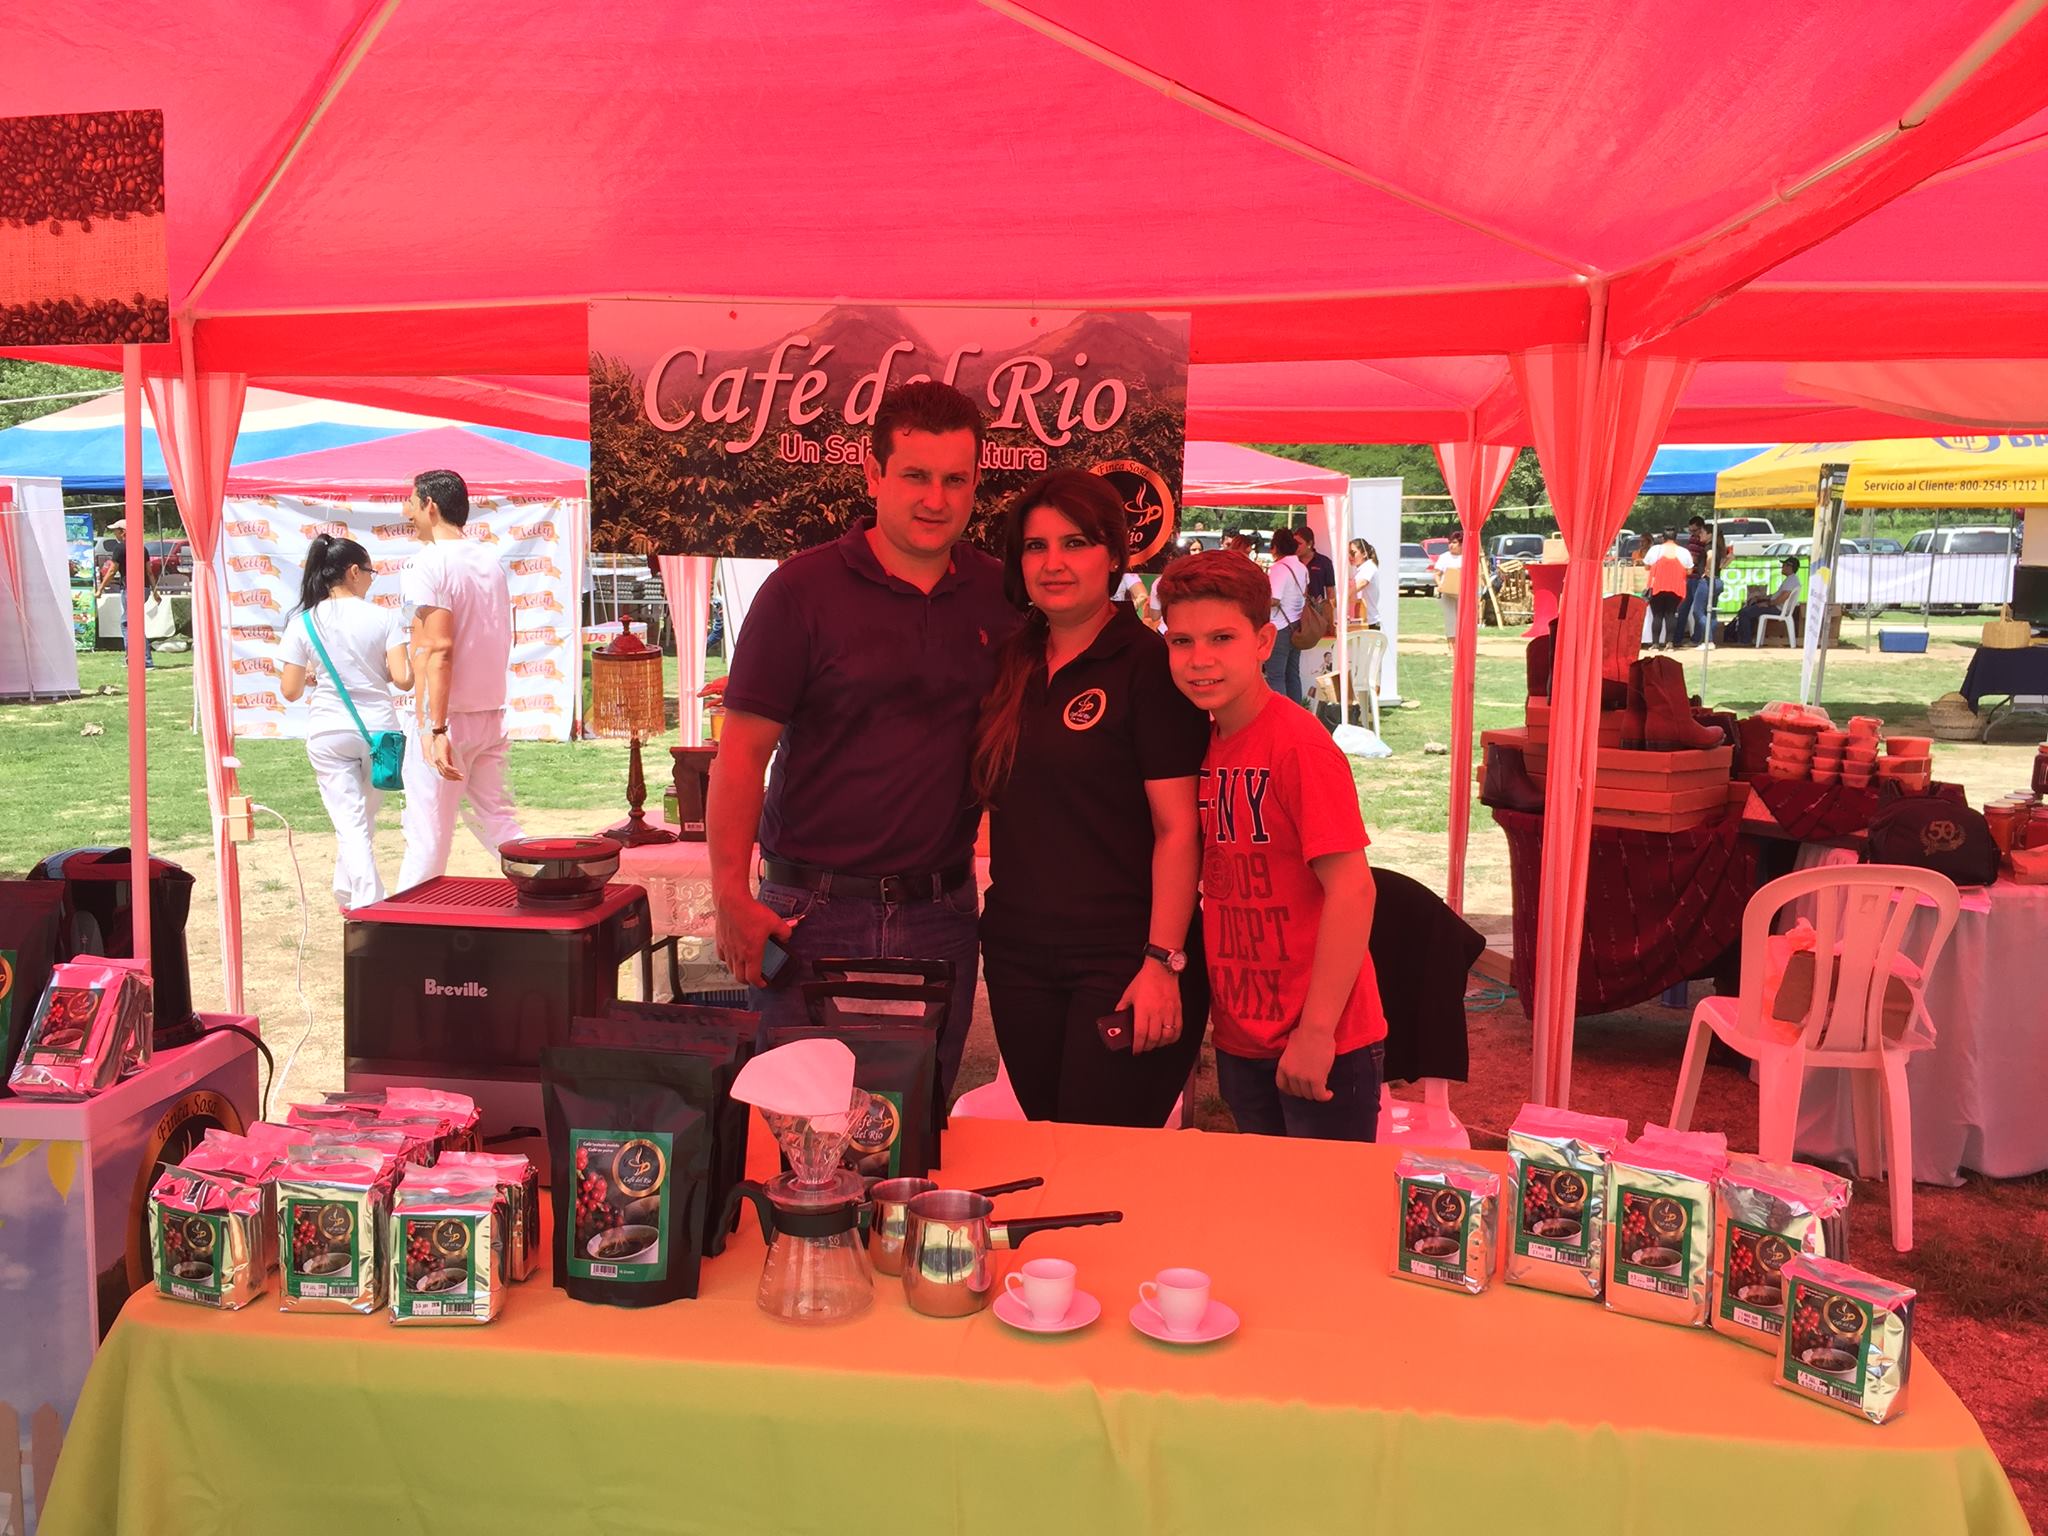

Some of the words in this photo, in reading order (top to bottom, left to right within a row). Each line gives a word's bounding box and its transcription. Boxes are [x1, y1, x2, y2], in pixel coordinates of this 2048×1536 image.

[643, 334, 836, 454] Café
[843, 339, 983, 426] dl
[986, 352, 1128, 447] Rio
[780, 432, 820, 464] Un
[978, 439, 1047, 471] ltura
[1097, 463, 1125, 476] Finca
[1863, 480, 1905, 492] Servicio
[1906, 480, 1917, 491] al
[1918, 480, 1958, 492] Cliente:
[1959, 479, 2037, 492] 800-2545-1212
[1127, 527, 1144, 546] io
[1233, 851, 1273, 900] 09
[1217, 904, 1291, 963] DEPT
[424, 978, 489, 998] Breville
[157, 1102, 190, 1143] Finca
[191, 1094, 218, 1115] Sosa
